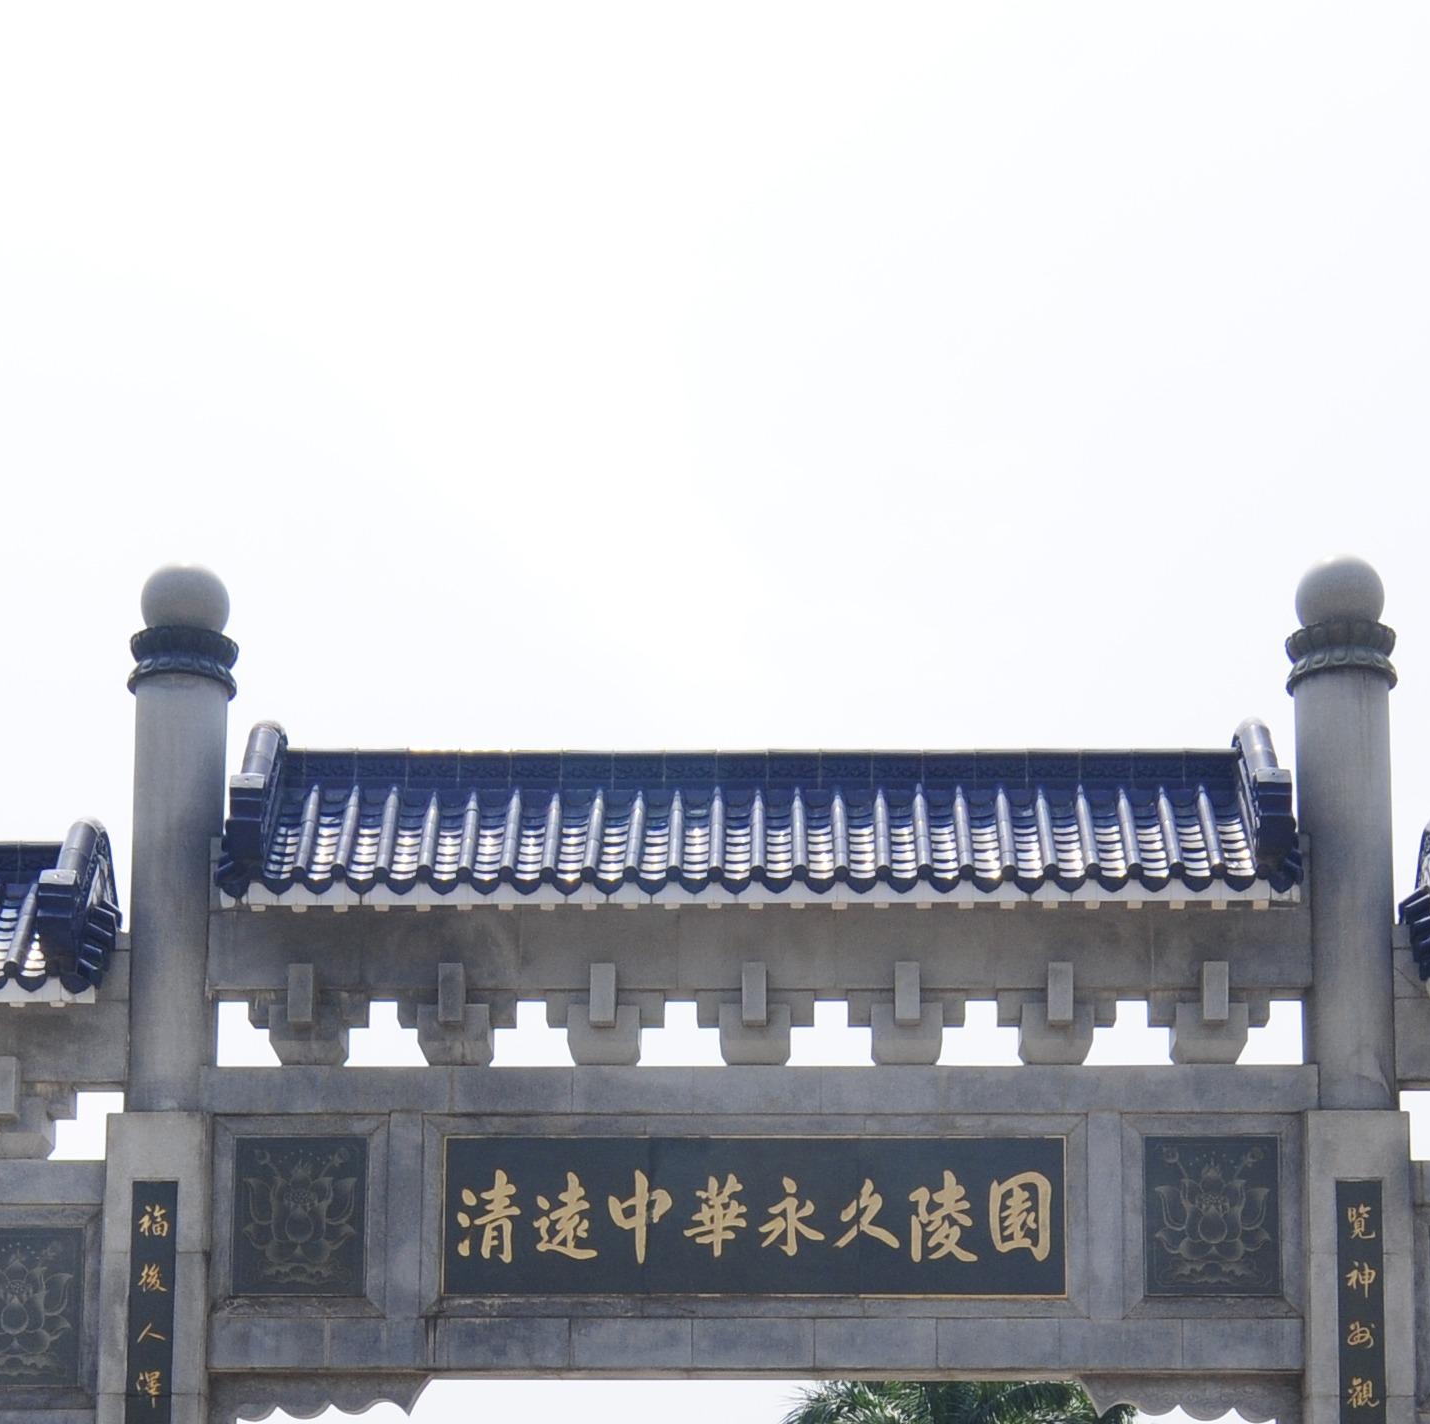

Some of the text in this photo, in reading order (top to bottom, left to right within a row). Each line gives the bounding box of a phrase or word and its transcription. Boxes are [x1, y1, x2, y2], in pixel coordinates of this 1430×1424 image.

[456, 1169, 1052, 1263] 清遠中華永久陵園
